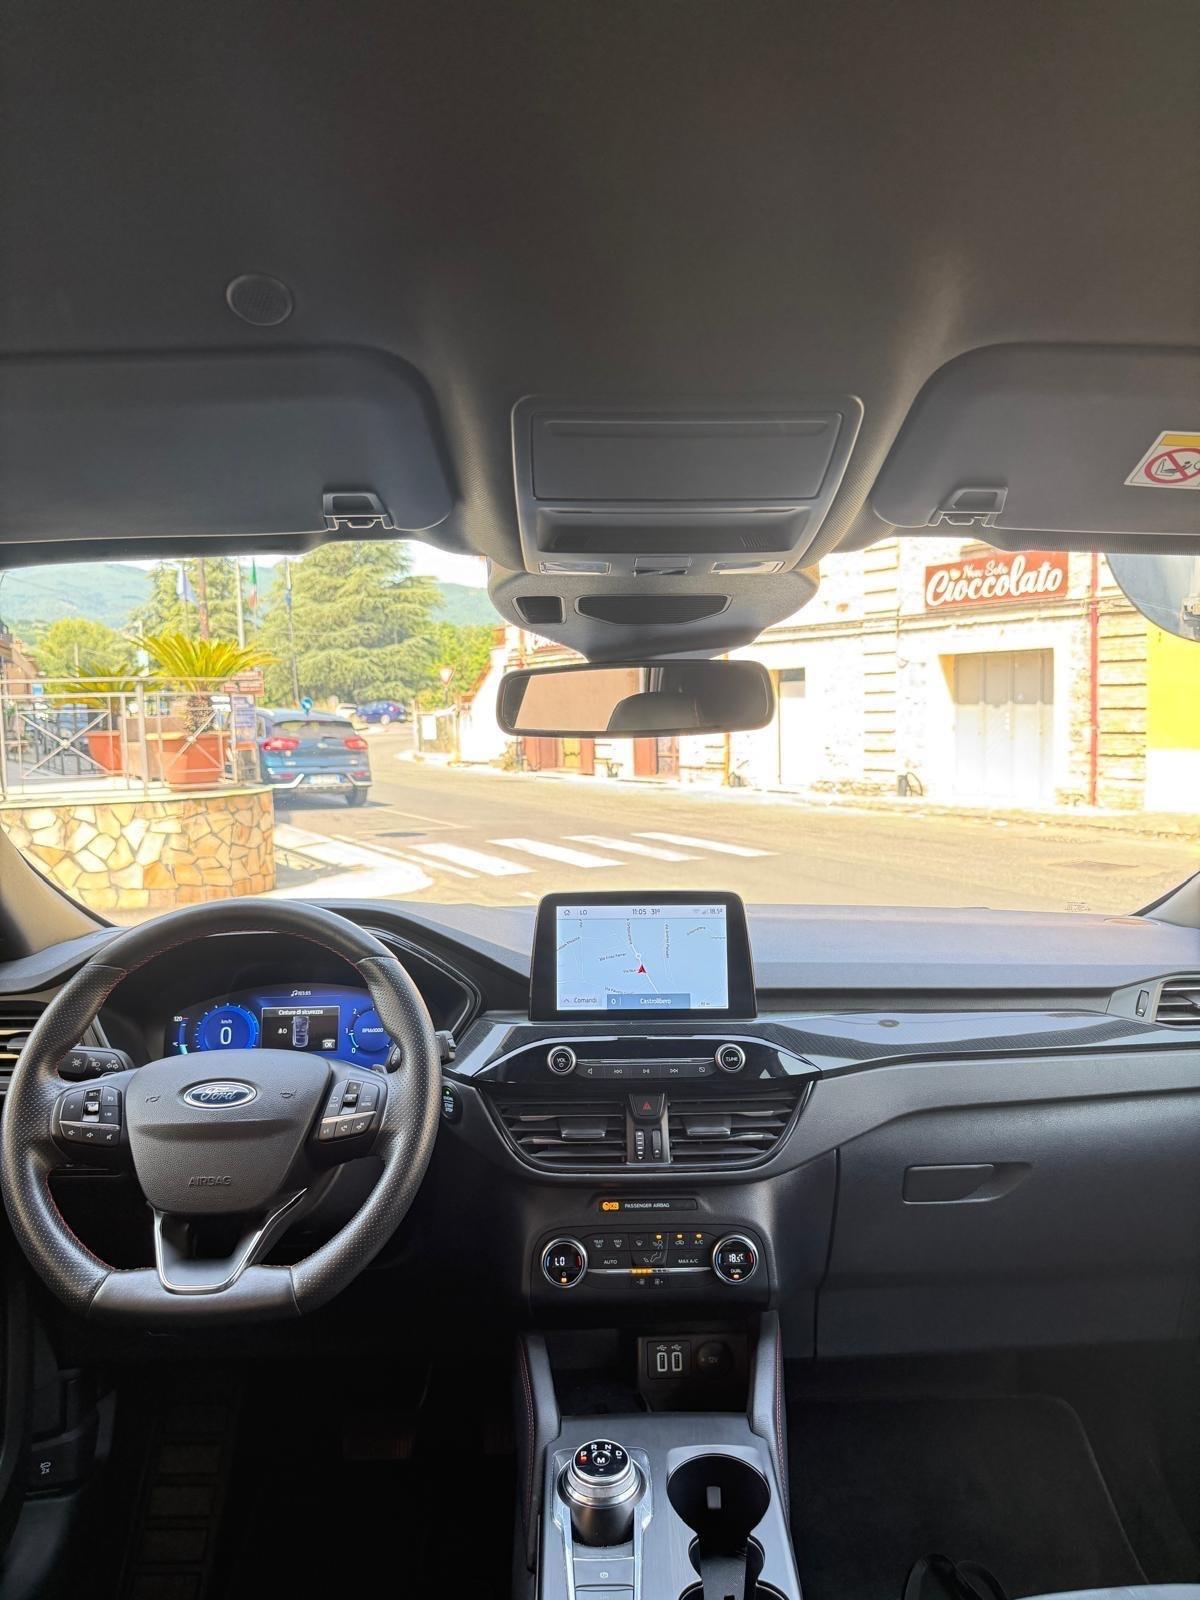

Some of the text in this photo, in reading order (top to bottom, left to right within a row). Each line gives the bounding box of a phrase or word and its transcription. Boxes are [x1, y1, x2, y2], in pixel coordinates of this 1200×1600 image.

[926, 555, 1063, 606] Cioccolato
[632, 908, 647, 916] 11:05
[573, 996, 598, 1004] Comandi
[220, 1026, 232, 1045] 0
[200, 1087, 236, 1101] Ford
[188, 1175, 233, 1187] AIRBAG
